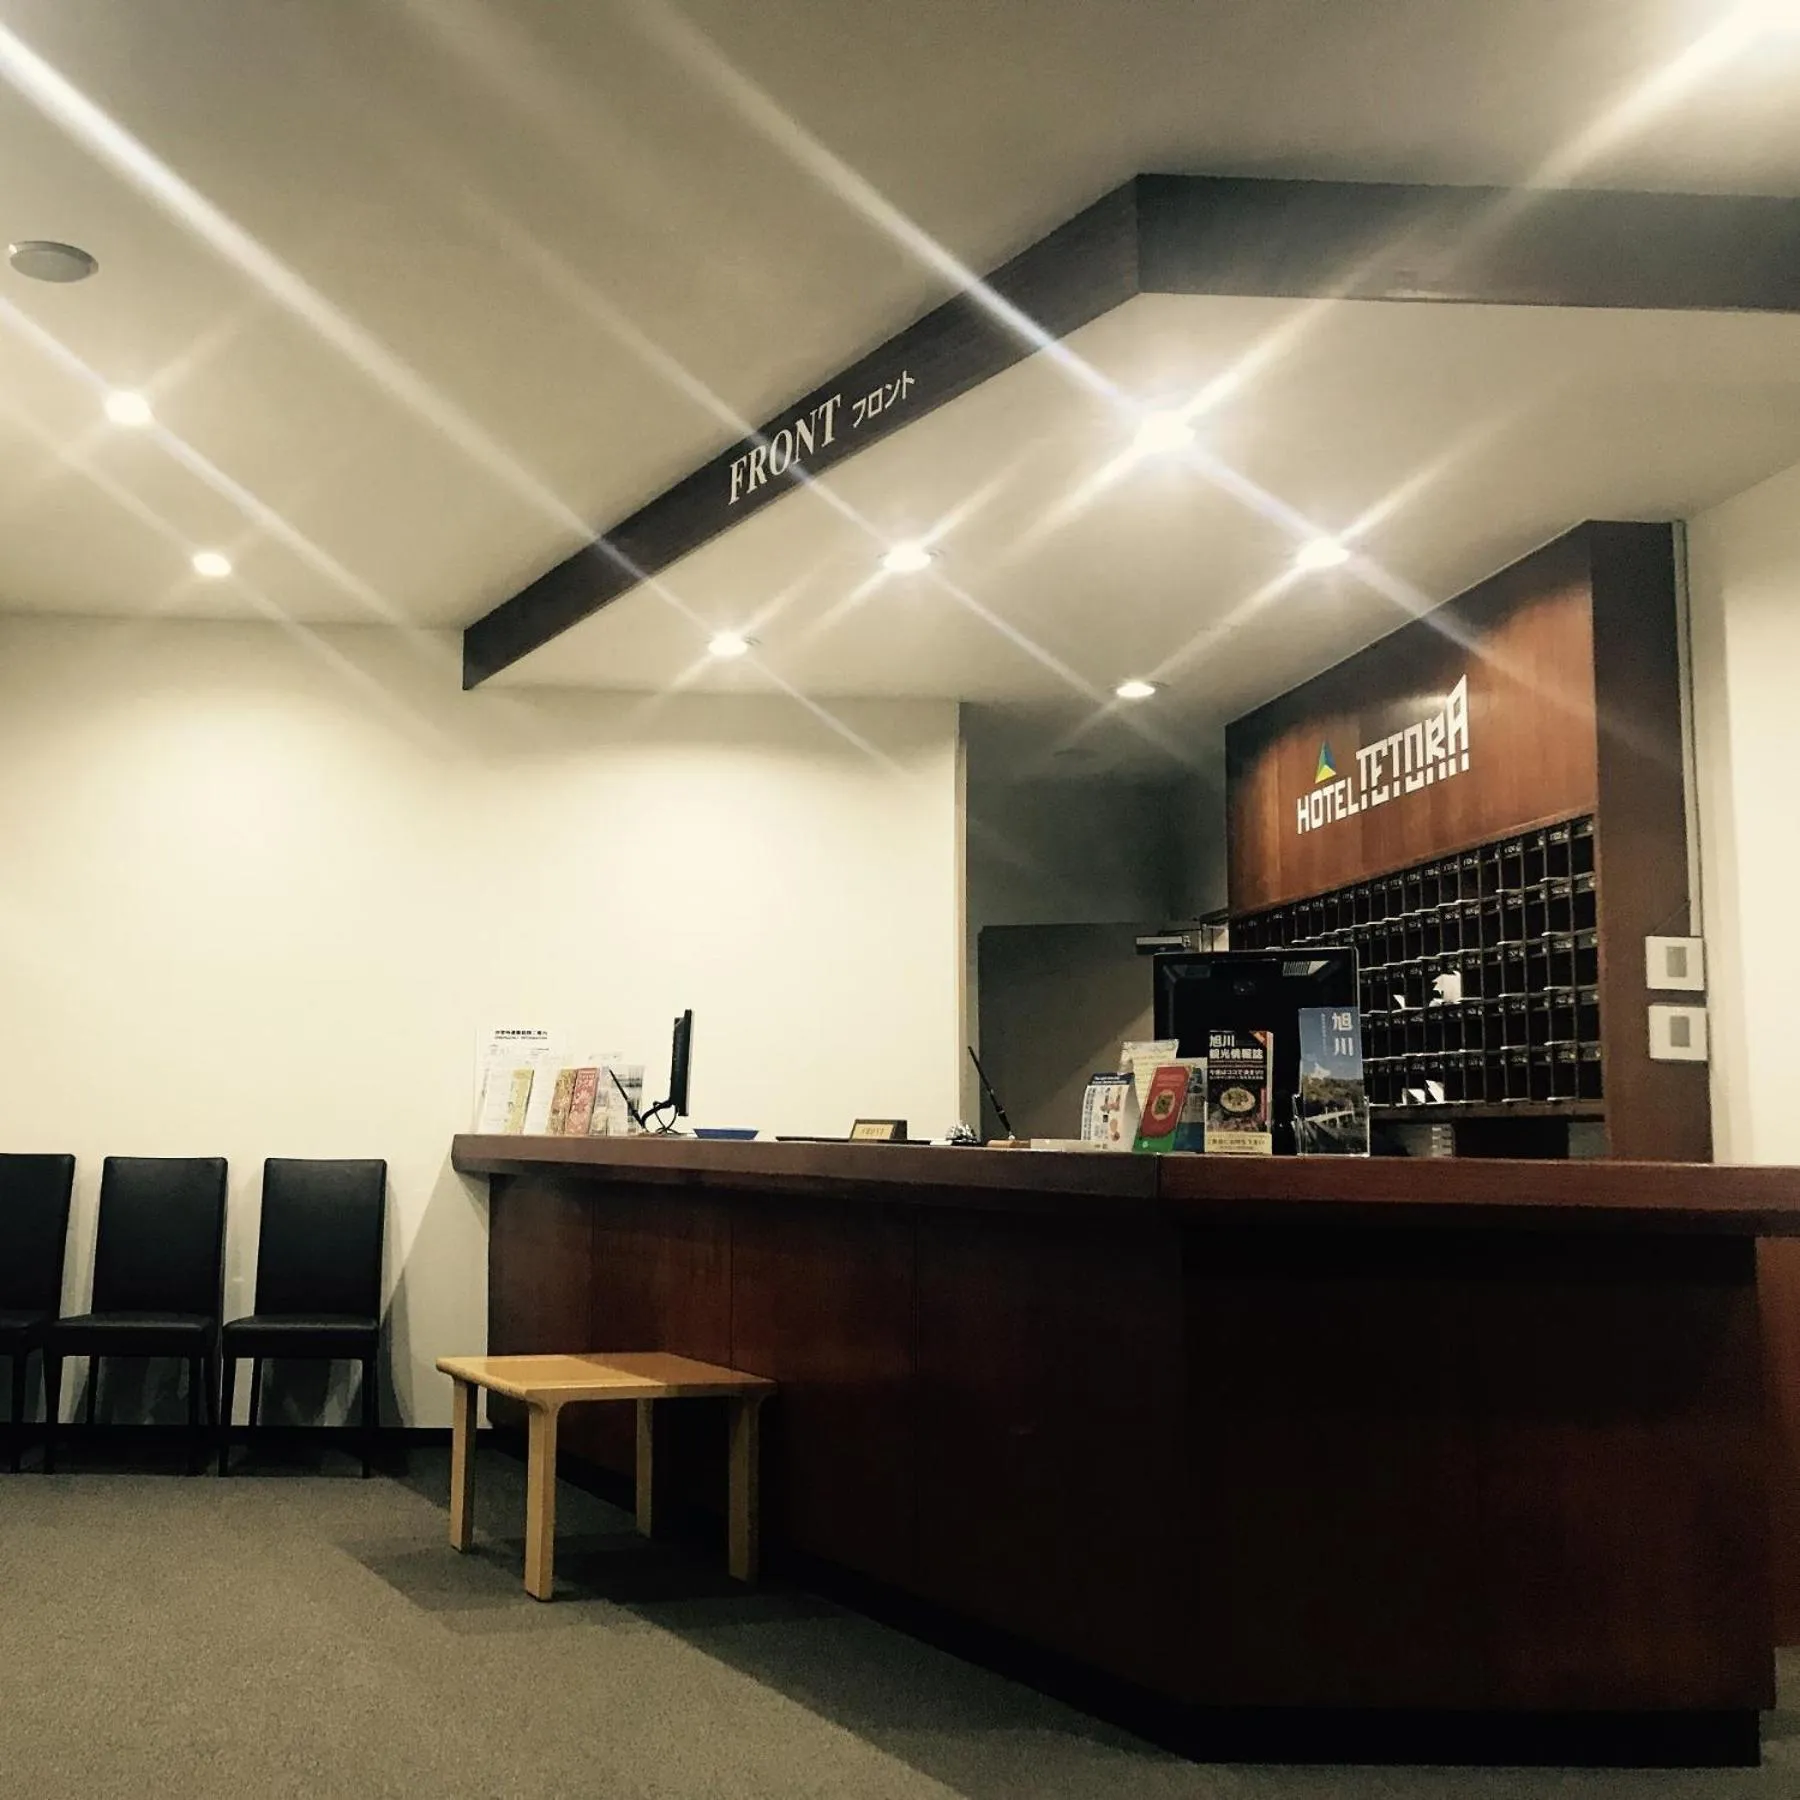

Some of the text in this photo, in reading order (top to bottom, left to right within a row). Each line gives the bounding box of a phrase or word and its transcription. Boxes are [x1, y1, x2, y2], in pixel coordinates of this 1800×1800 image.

[728, 370, 915, 505] FRONT フロント
[1297, 674, 1470, 835] HOTEL TETORA
[1209, 1034, 1235, 1048] 旭川
[1331, 1011, 1354, 1057] 旭川
